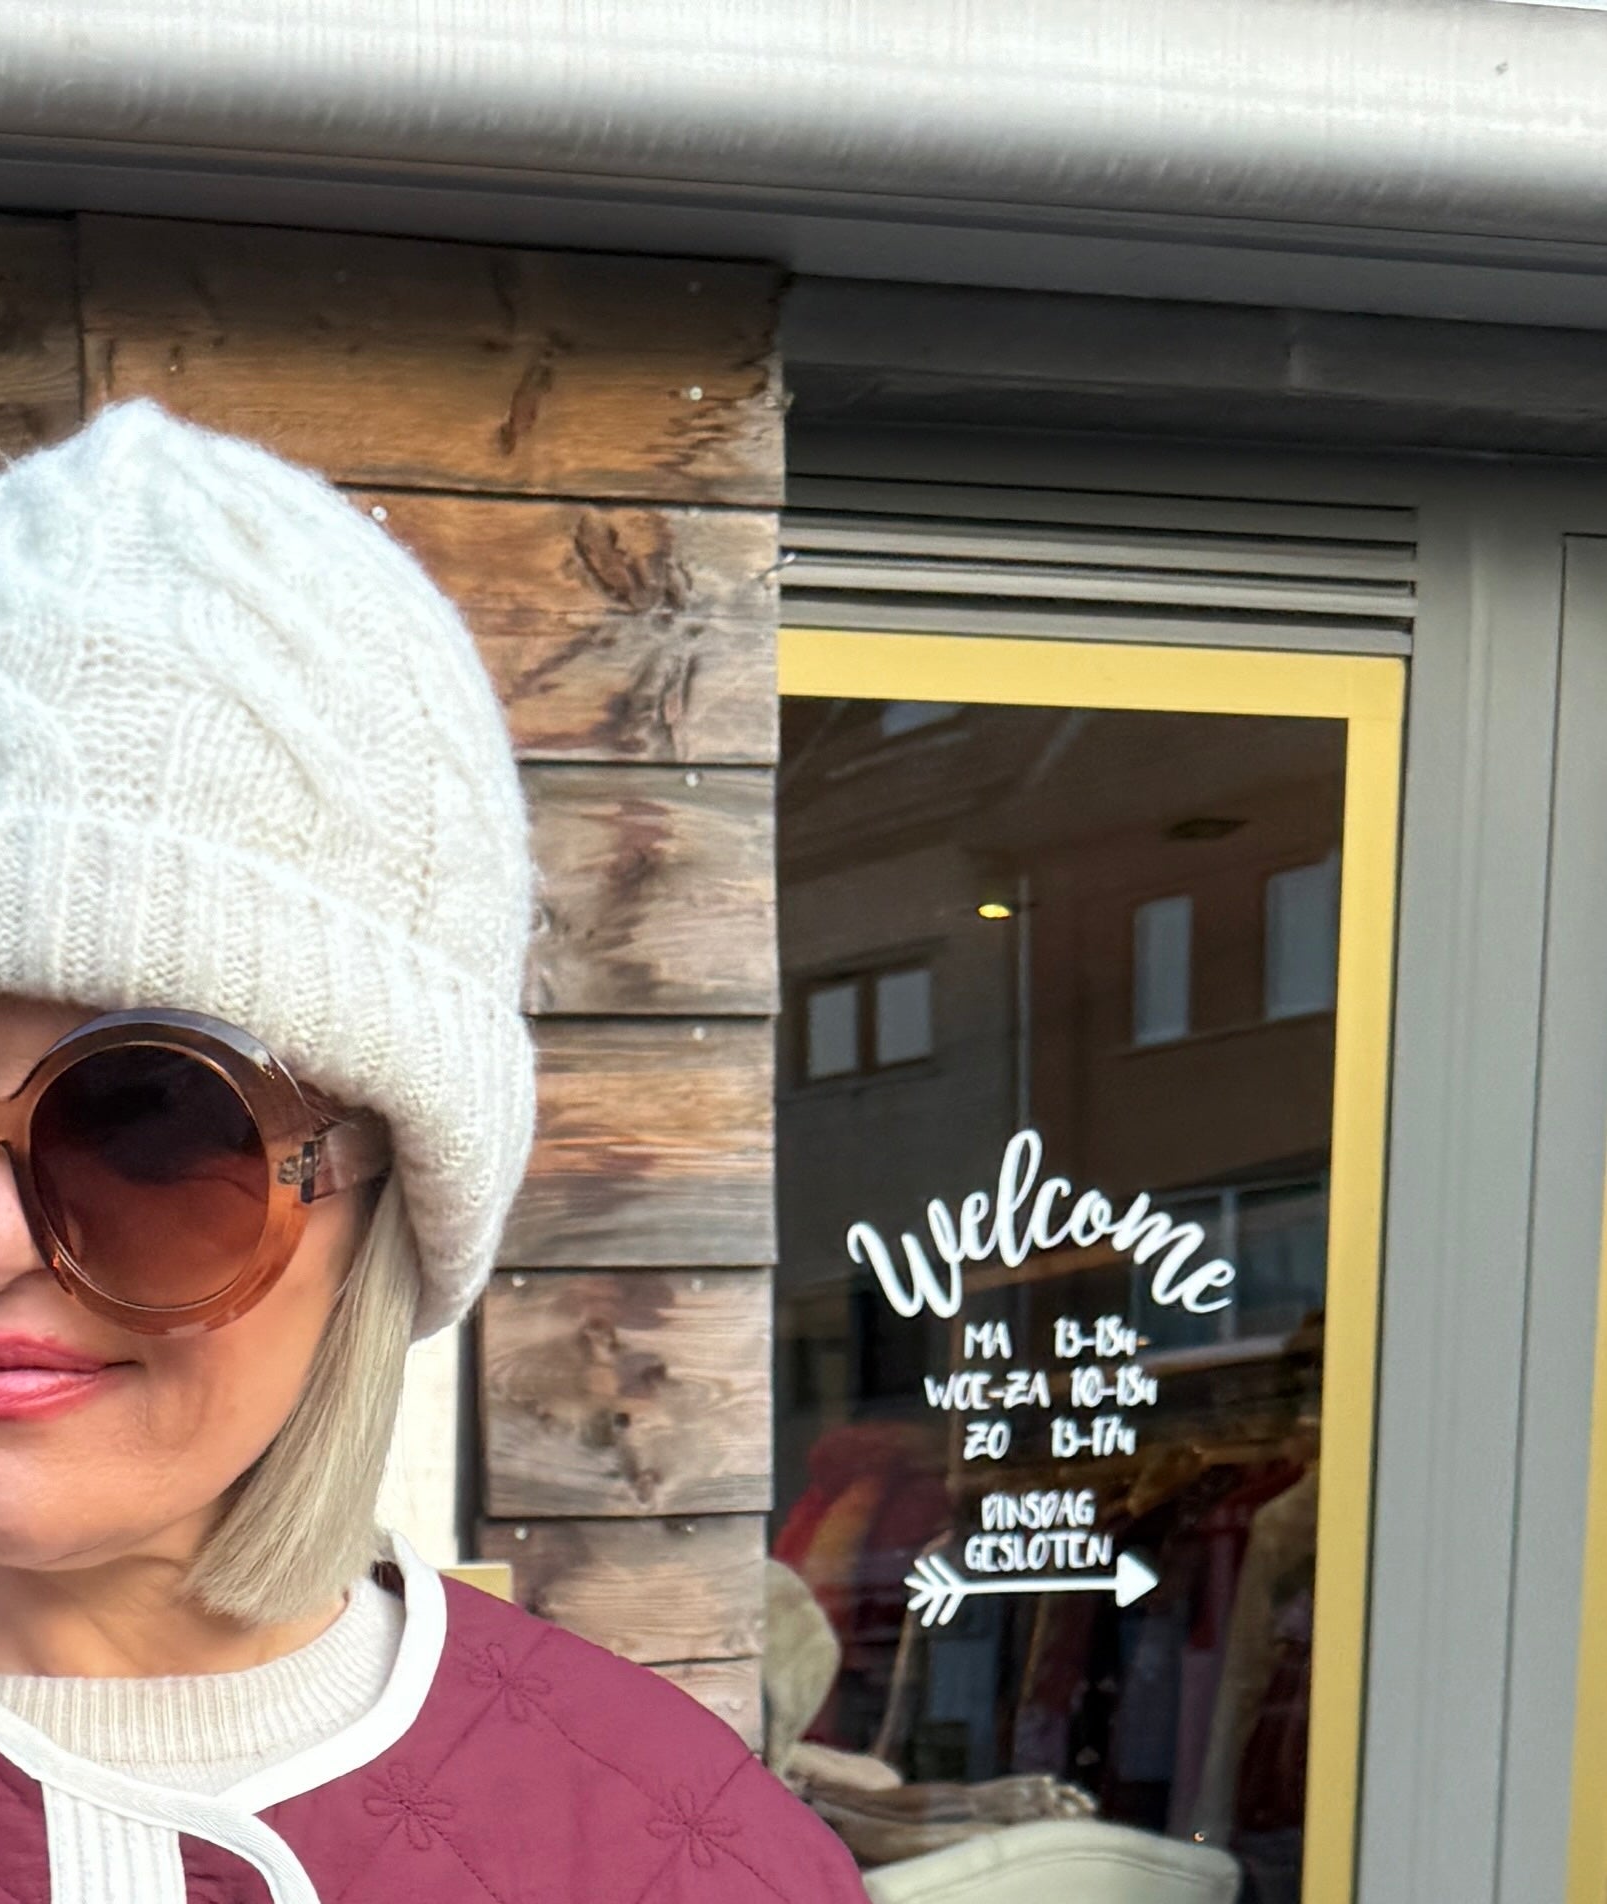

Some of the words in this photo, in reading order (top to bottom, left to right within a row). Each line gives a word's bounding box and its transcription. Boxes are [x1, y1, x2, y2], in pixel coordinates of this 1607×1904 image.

[847, 1129, 1236, 1317] Welcome
[964, 1320, 1012, 1359] MA
[923, 1370, 1050, 1410] WOE-ZA
[963, 1420, 1011, 1460] ZO
[981, 1489, 1095, 1531] DINSDAG
[964, 1531, 1113, 1572] GESLOTEN
